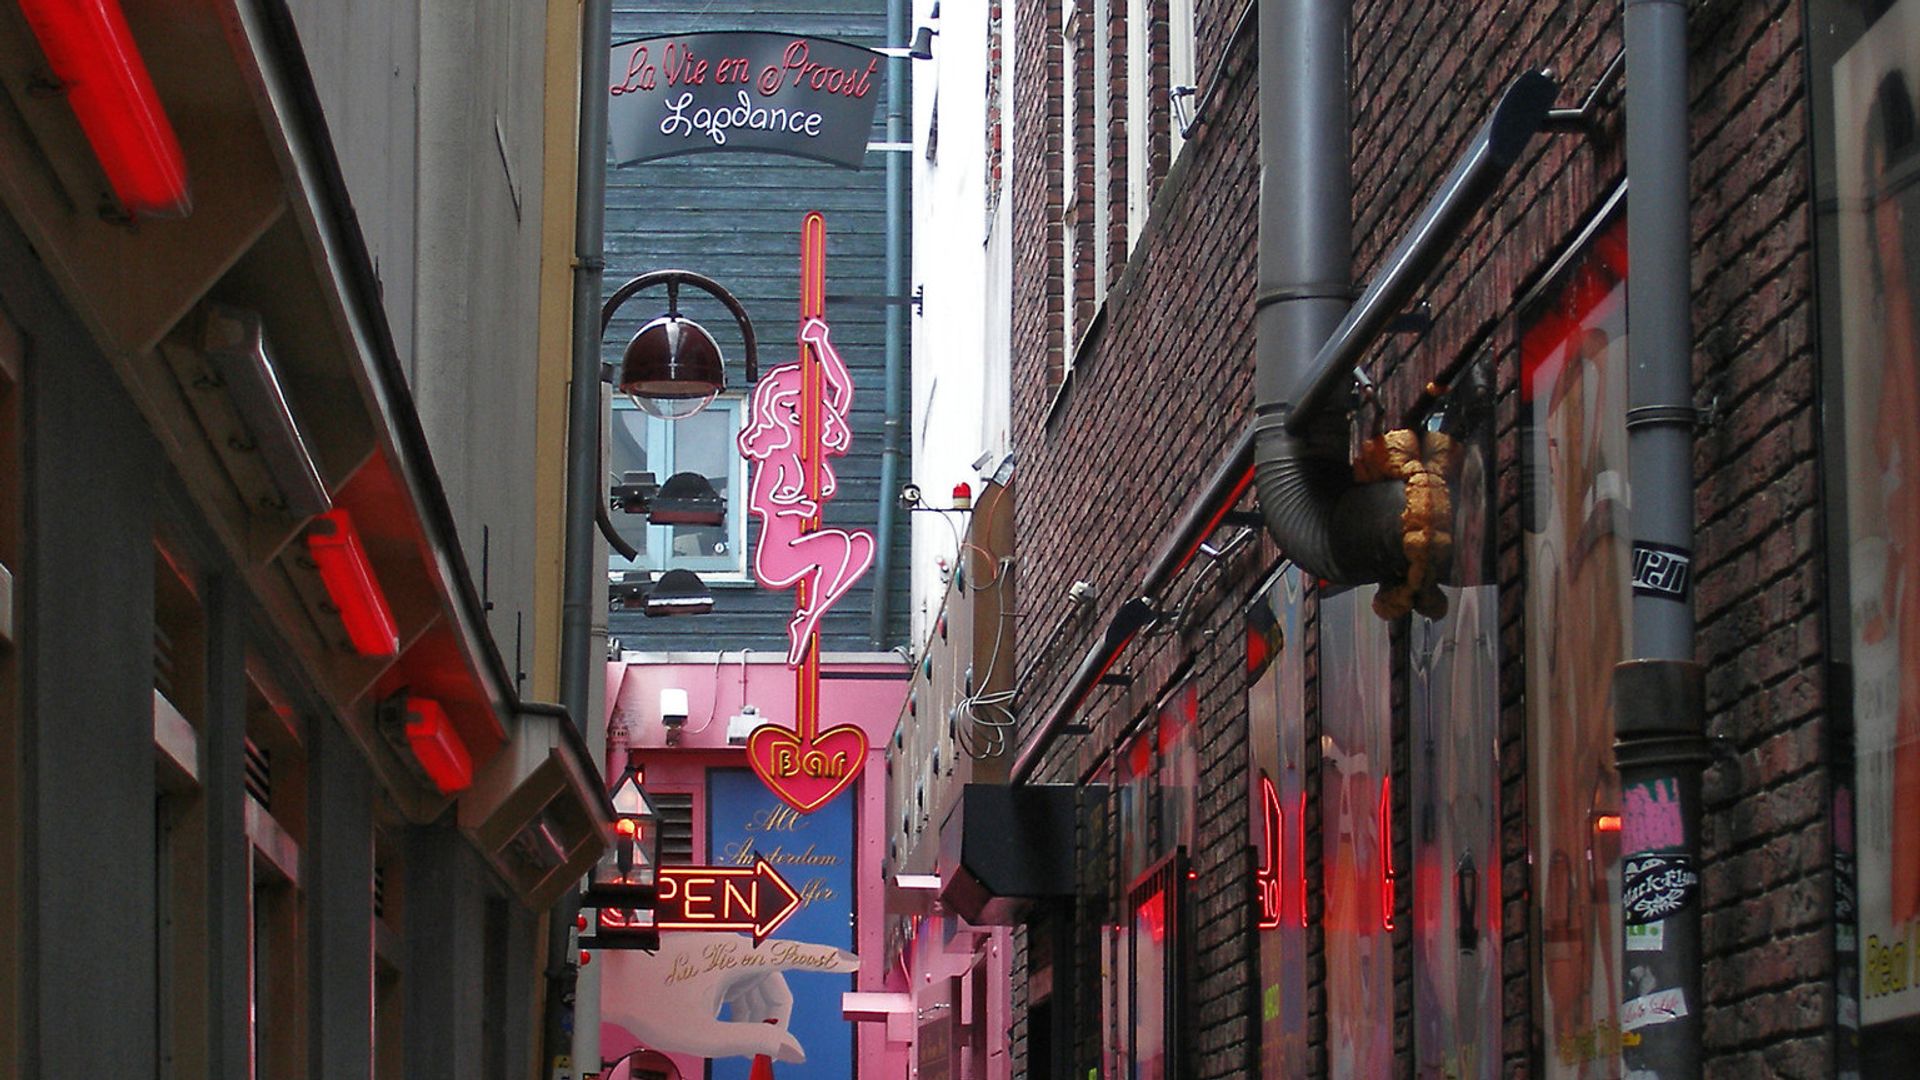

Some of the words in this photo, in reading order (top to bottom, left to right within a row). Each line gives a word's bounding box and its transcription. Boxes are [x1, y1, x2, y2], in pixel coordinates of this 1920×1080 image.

[609, 46, 657, 95] La
[662, 41, 709, 86] Vie
[714, 57, 749, 85] en
[757, 38, 878, 98] Proost
[659, 89, 823, 145] Lapdance
[770, 741, 847, 777] Bar
[745, 803, 810, 831] All
[657, 876, 757, 919] PEN
[800, 877, 838, 909] ffer
[702, 942, 738, 973] Vie
[742, 953, 766, 967] en
[770, 940, 839, 970] Proost
